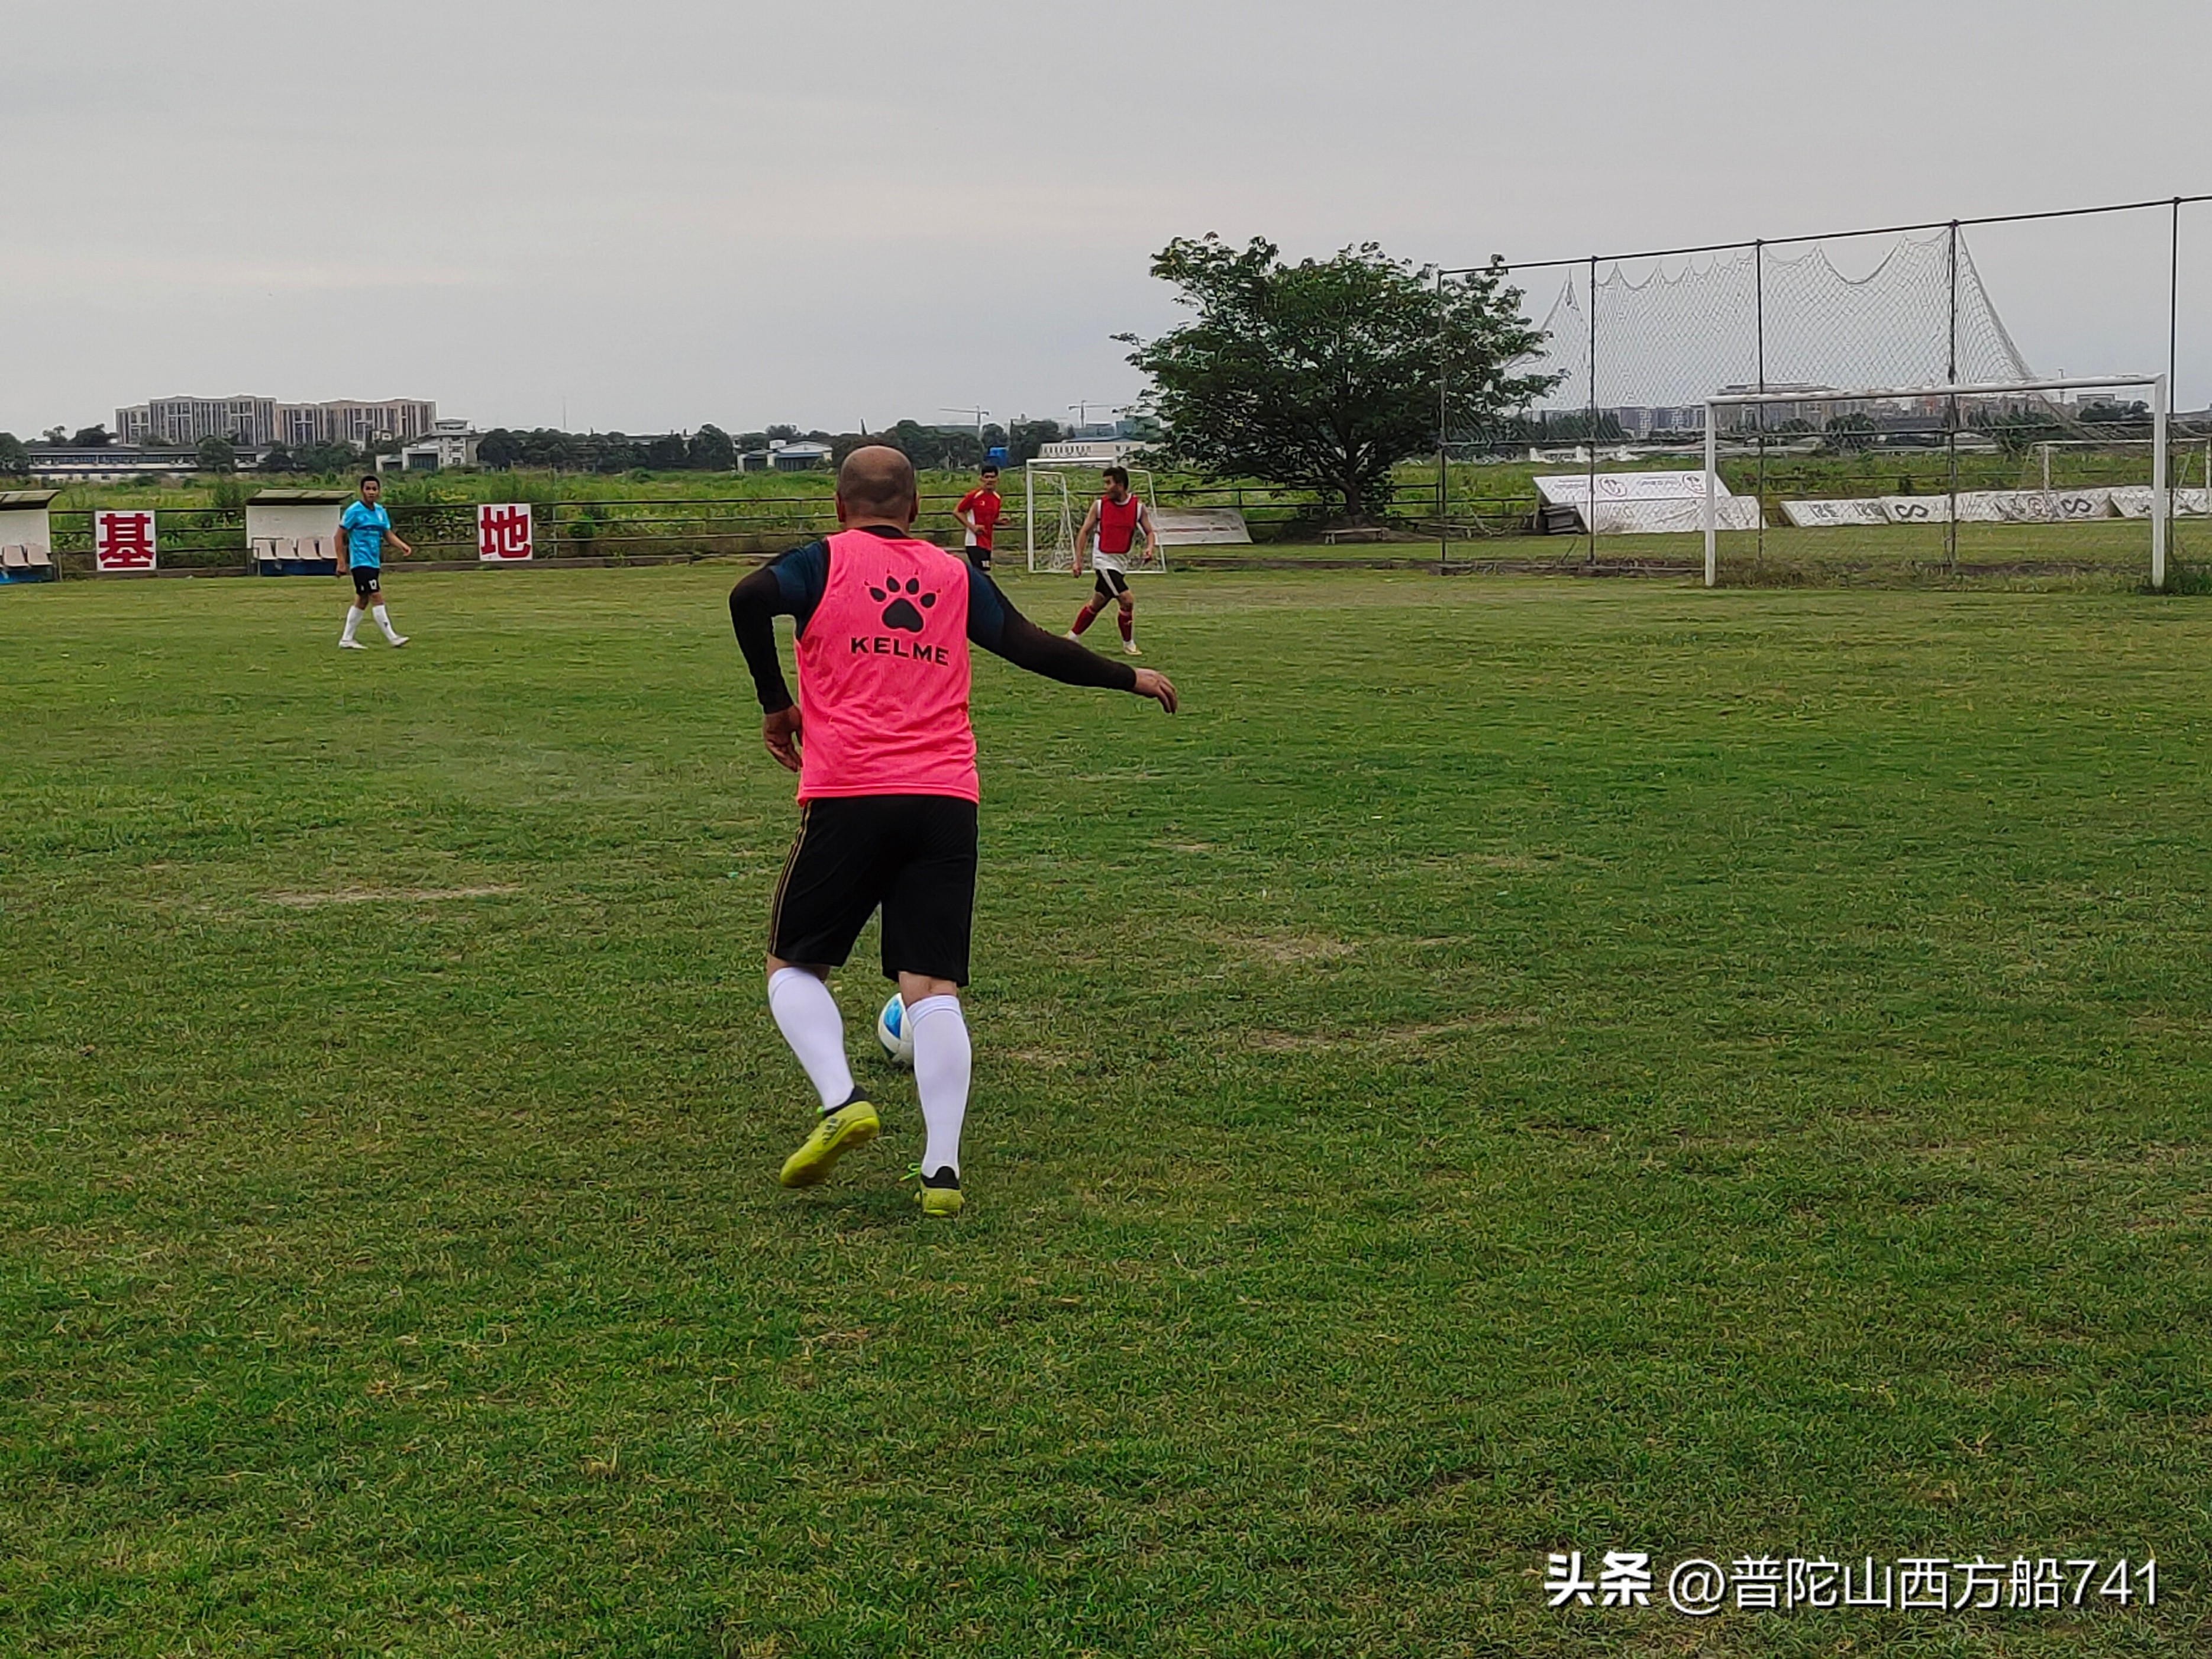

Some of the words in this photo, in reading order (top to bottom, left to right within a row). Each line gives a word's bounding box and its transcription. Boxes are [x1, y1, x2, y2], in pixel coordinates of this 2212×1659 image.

[99, 513, 154, 568] 基
[480, 505, 531, 559] 地
[851, 636, 950, 667] KELME
